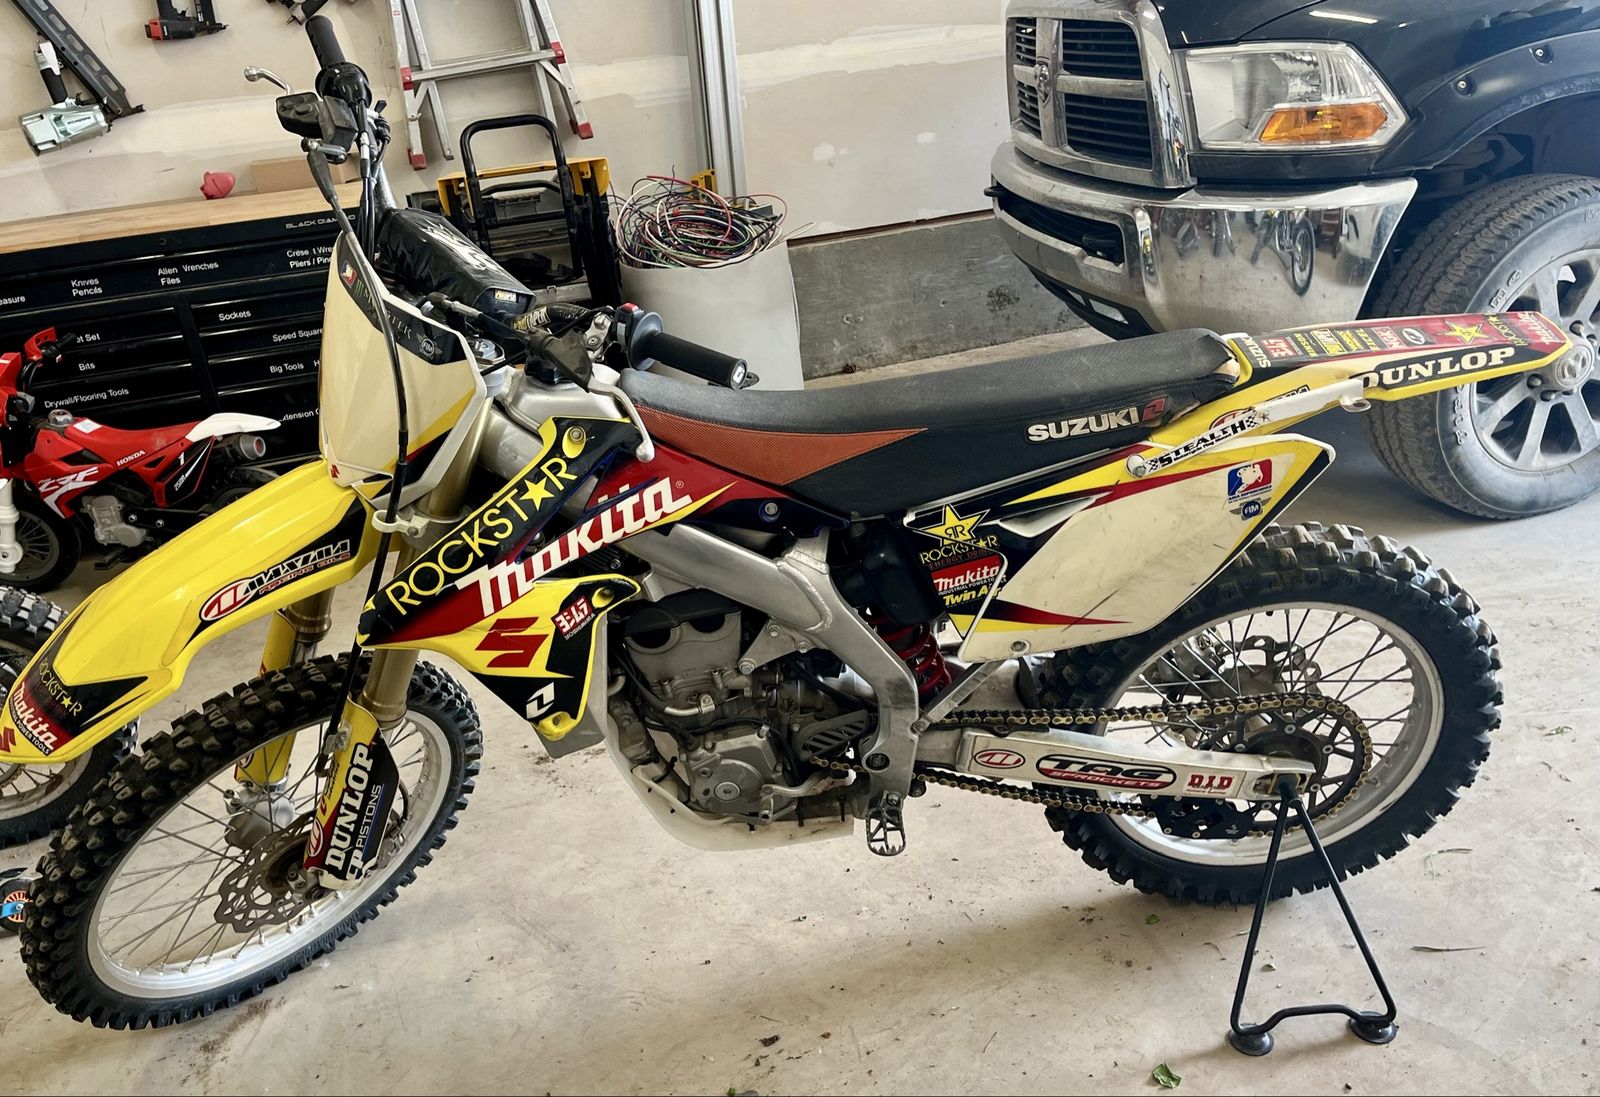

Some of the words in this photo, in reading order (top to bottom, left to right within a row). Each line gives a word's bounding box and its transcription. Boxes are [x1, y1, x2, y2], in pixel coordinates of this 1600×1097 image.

[285, 221, 316, 229] BLACK
[286, 248, 316, 258] Creset
[290, 260, 311, 269] Pliers
[317, 257, 331, 265] Pin
[158, 267, 178, 276] Allen
[71, 278, 99, 287] Knives
[160, 278, 181, 286] Files
[72, 286, 103, 296] Pencils
[0, 295, 26, 306] easure
[218, 310, 251, 322] Sockets
[85, 333, 101, 342] Set
[272, 331, 296, 342] Speed
[78, 362, 96, 371] Bits
[270, 365, 283, 374] Big
[283, 362, 304, 371] Tools
[44, 391, 107, 409] Drywall/Flooring
[107, 388, 130, 397] Tools
[280, 410, 314, 421] xtension
[1027, 407, 1139, 442] SUZUKI
[1158, 419, 1246, 468] STEALTH
[116, 450, 146, 467] HONDA
[1244, 504, 1260, 515] FIM
[966, 548, 990, 559] DRIN
[938, 585, 968, 596] INDUSTRIAL
[968, 580, 987, 589] POWER
[943, 590, 976, 606] Twin
[555, 598, 589, 633] ヨシムラ
[17, 719, 32, 740] POWER
[31, 737, 51, 755] TOOLS
[1043, 757, 1170, 780] TAG
[1050, 770, 1163, 787] SPROCKETS
[325, 744, 374, 871] DUNLOP
[355, 784, 383, 848] PISTONS
